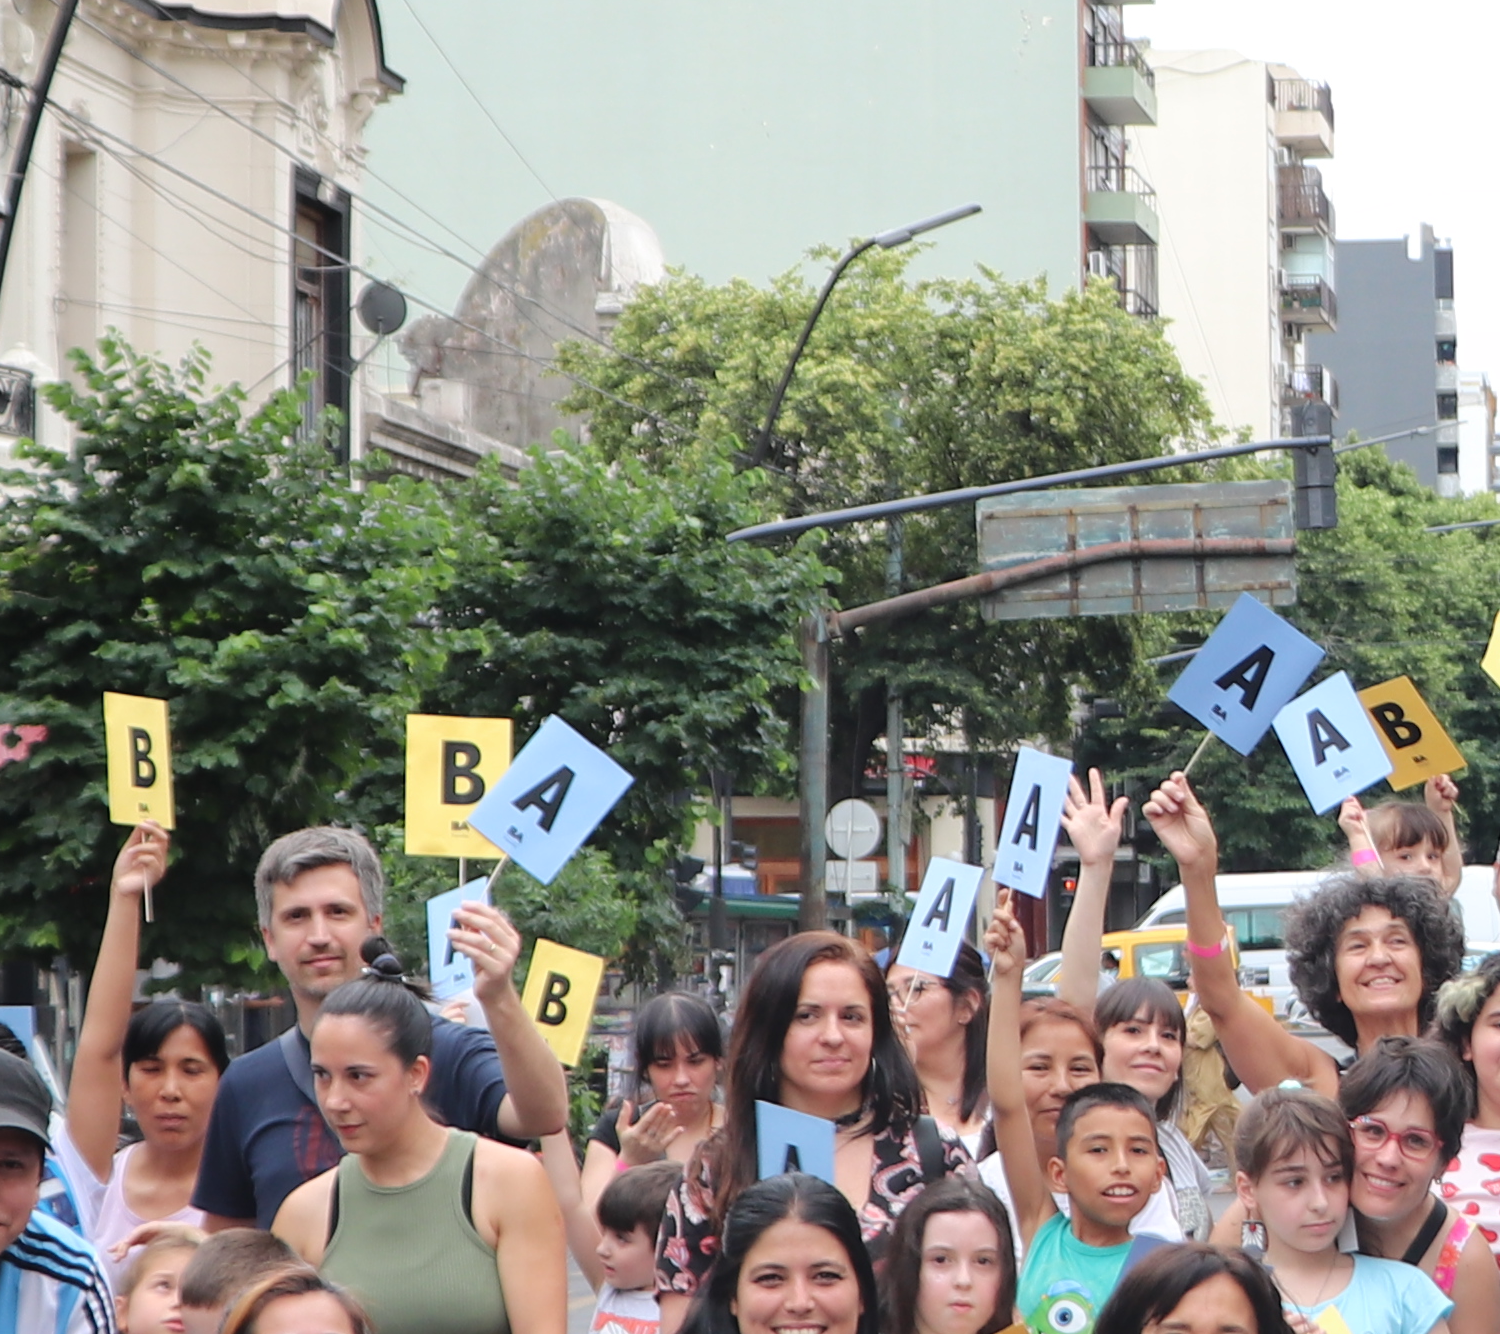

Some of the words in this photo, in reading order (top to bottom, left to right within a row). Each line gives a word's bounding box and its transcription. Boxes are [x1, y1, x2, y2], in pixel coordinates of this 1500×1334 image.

[1213, 644, 1276, 712] A
[1307, 708, 1352, 766] A
[1369, 701, 1423, 750] B
[130, 727, 157, 789] B
[442, 740, 486, 806] B
[512, 765, 576, 834] A
[1012, 784, 1042, 851] A
[922, 878, 956, 933] A
[536, 972, 571, 1027] B
